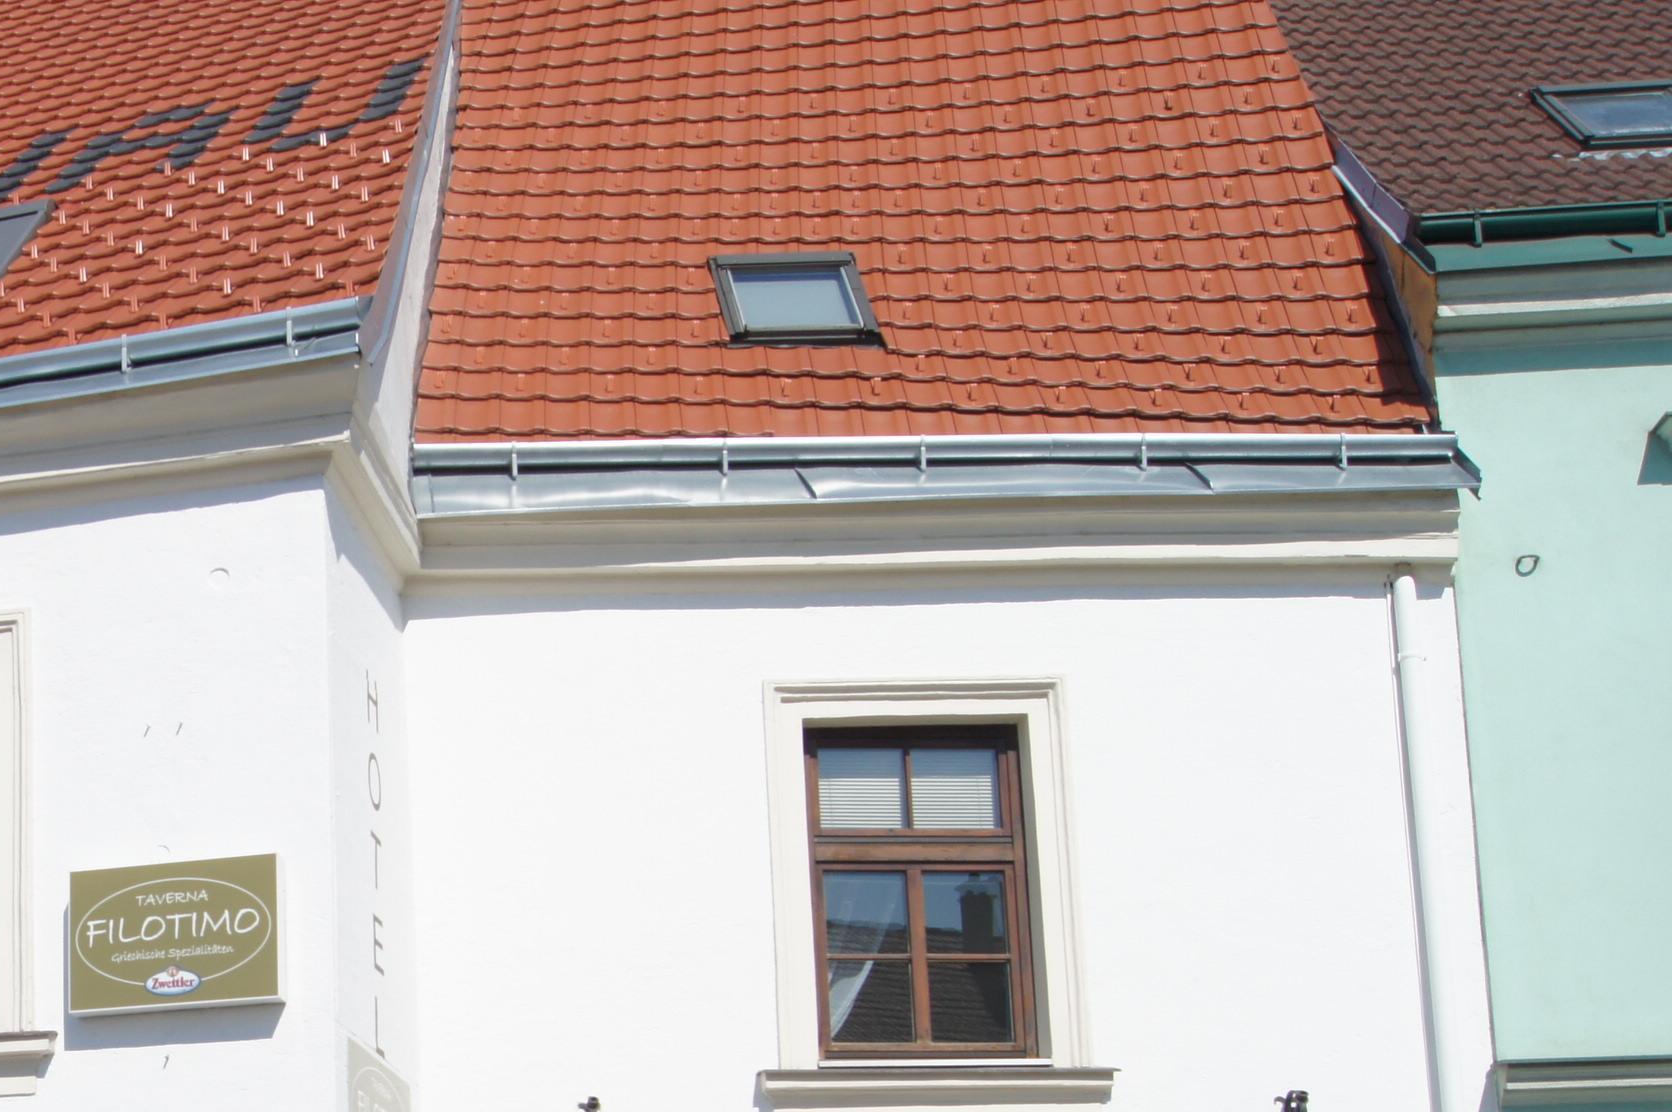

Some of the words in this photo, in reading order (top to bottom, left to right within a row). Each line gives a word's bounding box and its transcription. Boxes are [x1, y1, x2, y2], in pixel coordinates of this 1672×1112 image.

[365, 669, 386, 1060] HOTEL
[135, 888, 209, 908] TAVERNA
[86, 907, 261, 948] FILOTIMO
[110, 949, 166, 963] Griechische
[167, 944, 235, 961] Spezialitäten
[151, 976, 196, 990] Zwettler
